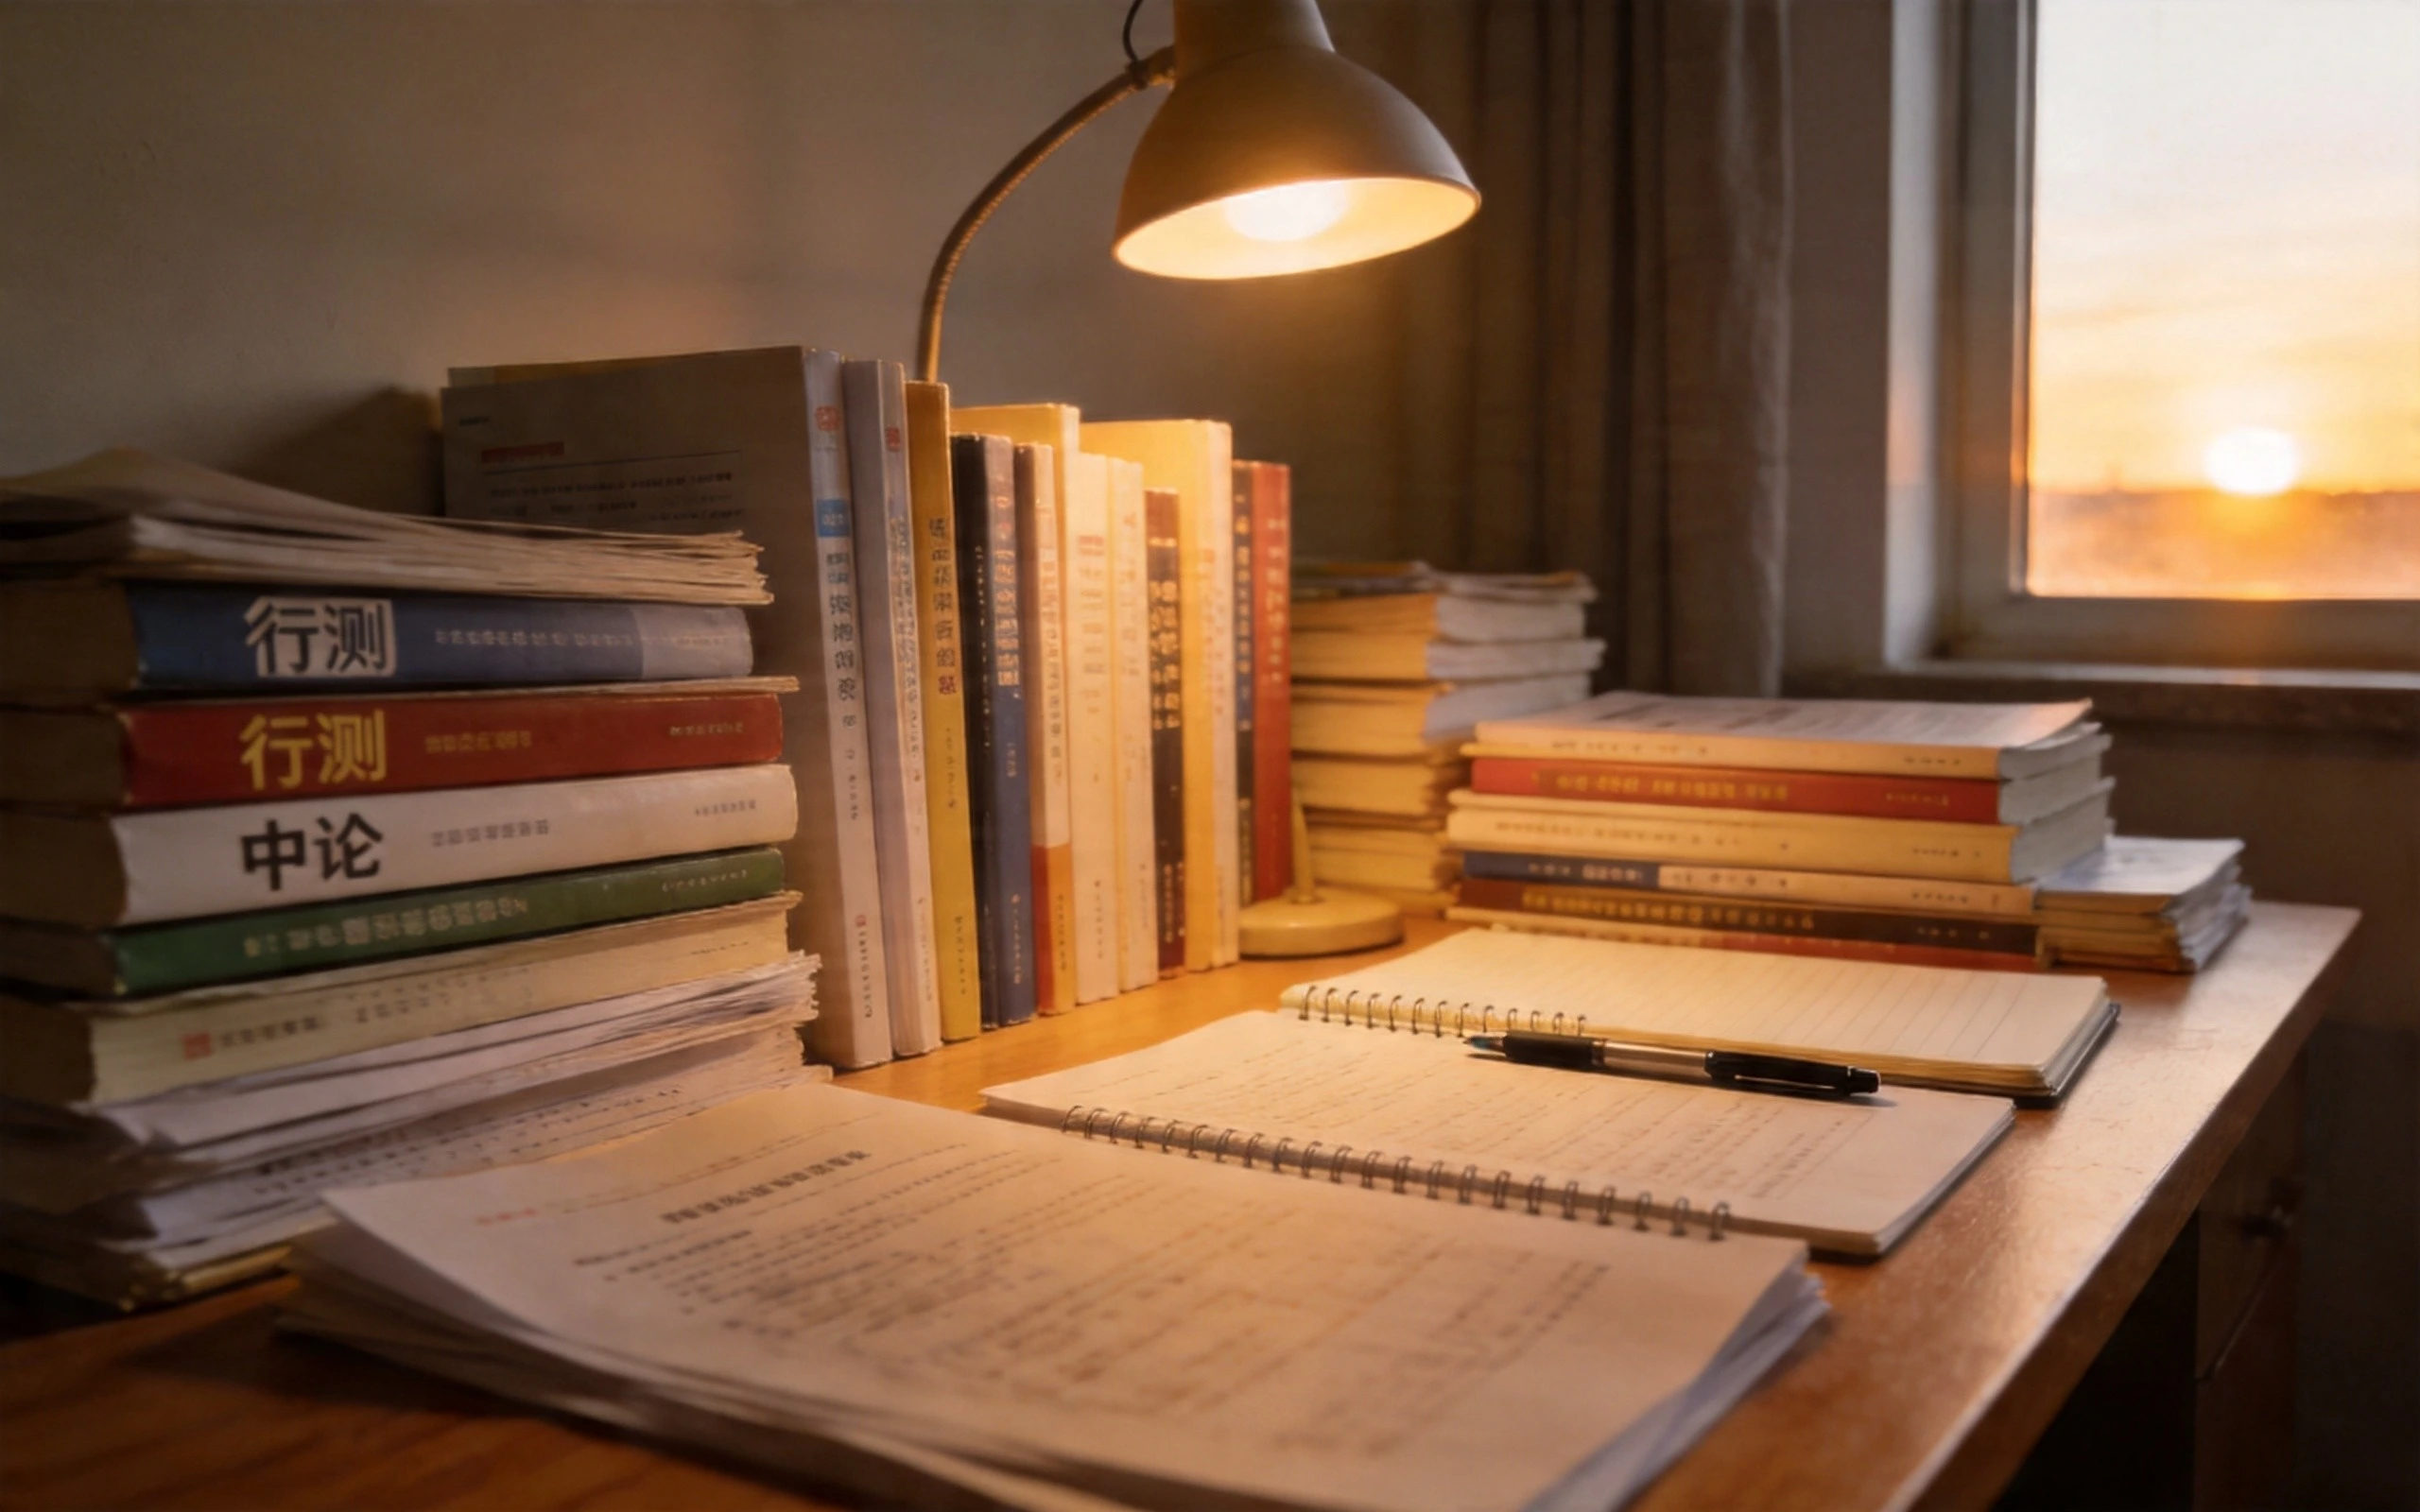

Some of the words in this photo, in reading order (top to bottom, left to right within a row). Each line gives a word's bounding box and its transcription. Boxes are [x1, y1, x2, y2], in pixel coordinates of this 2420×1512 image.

[246, 599, 389, 675] 行测
[239, 709, 387, 790] 行测
[240, 812, 383, 891] 中论
